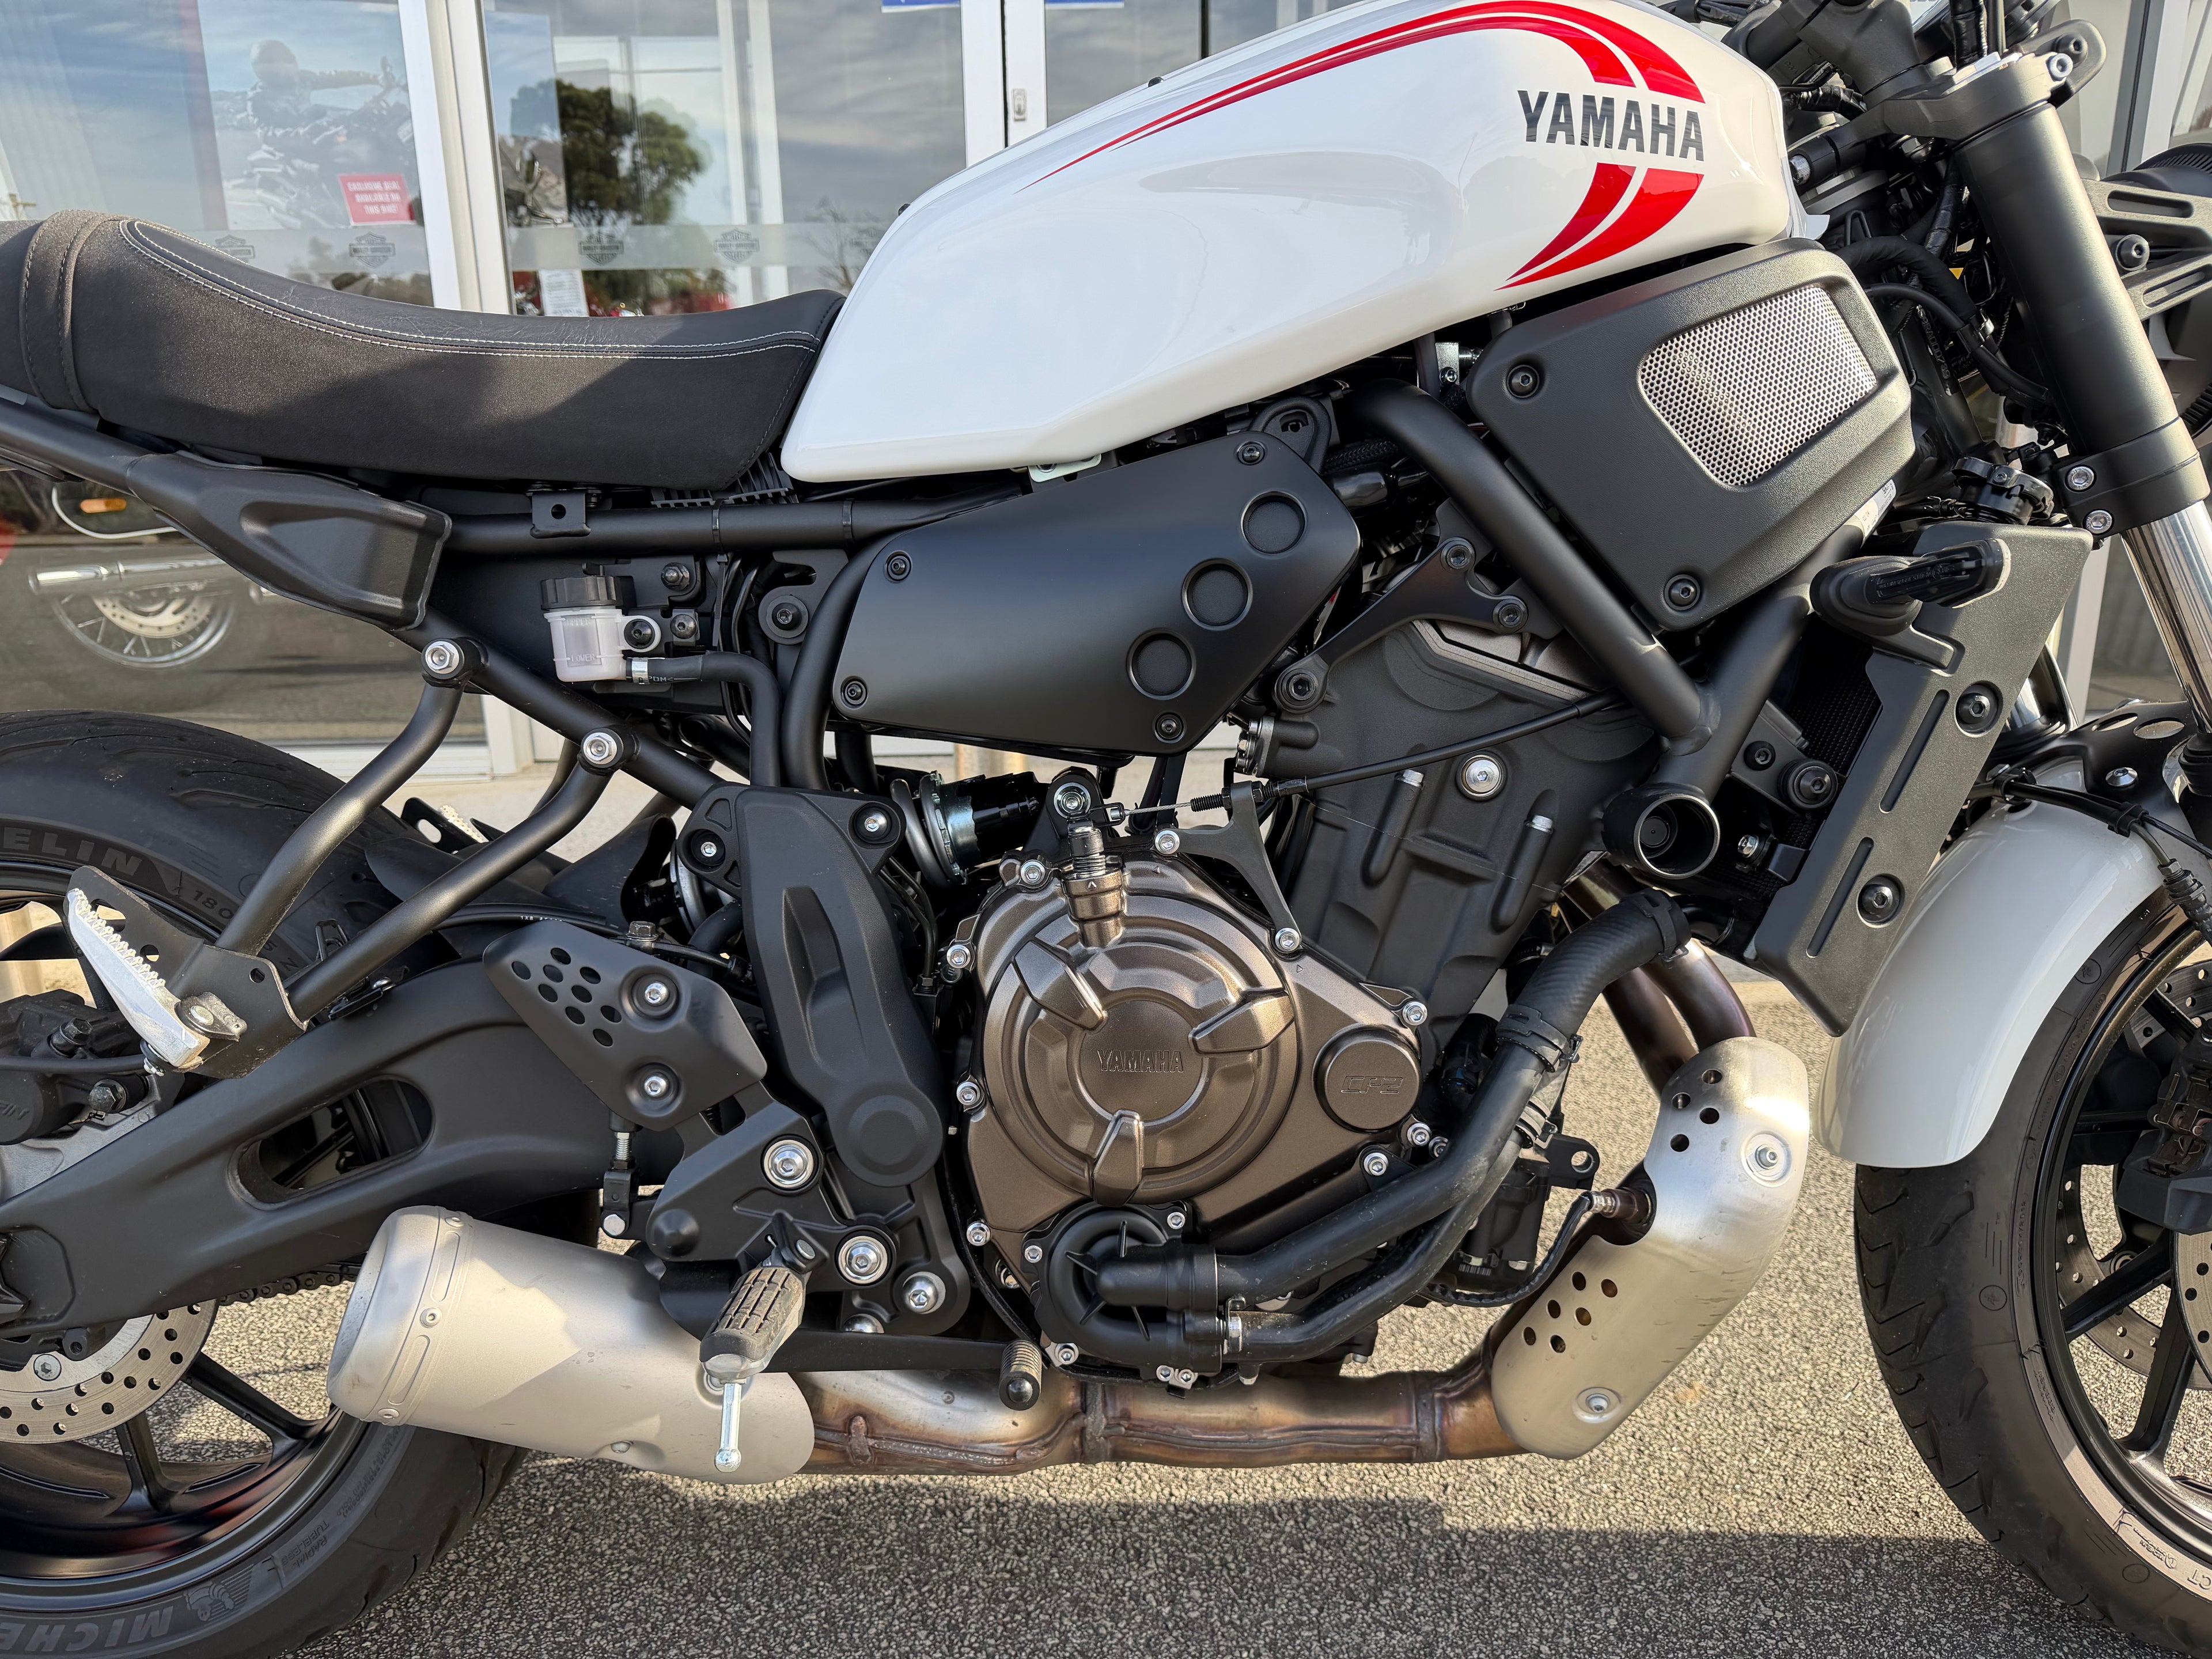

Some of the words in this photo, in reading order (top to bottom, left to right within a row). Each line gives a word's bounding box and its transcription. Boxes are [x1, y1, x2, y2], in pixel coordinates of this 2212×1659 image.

[1517, 90, 1705, 162] YAMAHA
[566, 617, 590, 626] UPPER
[571, 653, 595, 662] LOWER
[1097, 1049, 1184, 1073] YAMAHA
[1340, 1075, 1403, 1094] CP2
[281, 1520, 330, 1567] TUBELESS
[291, 1535, 328, 1567] RADIAL
